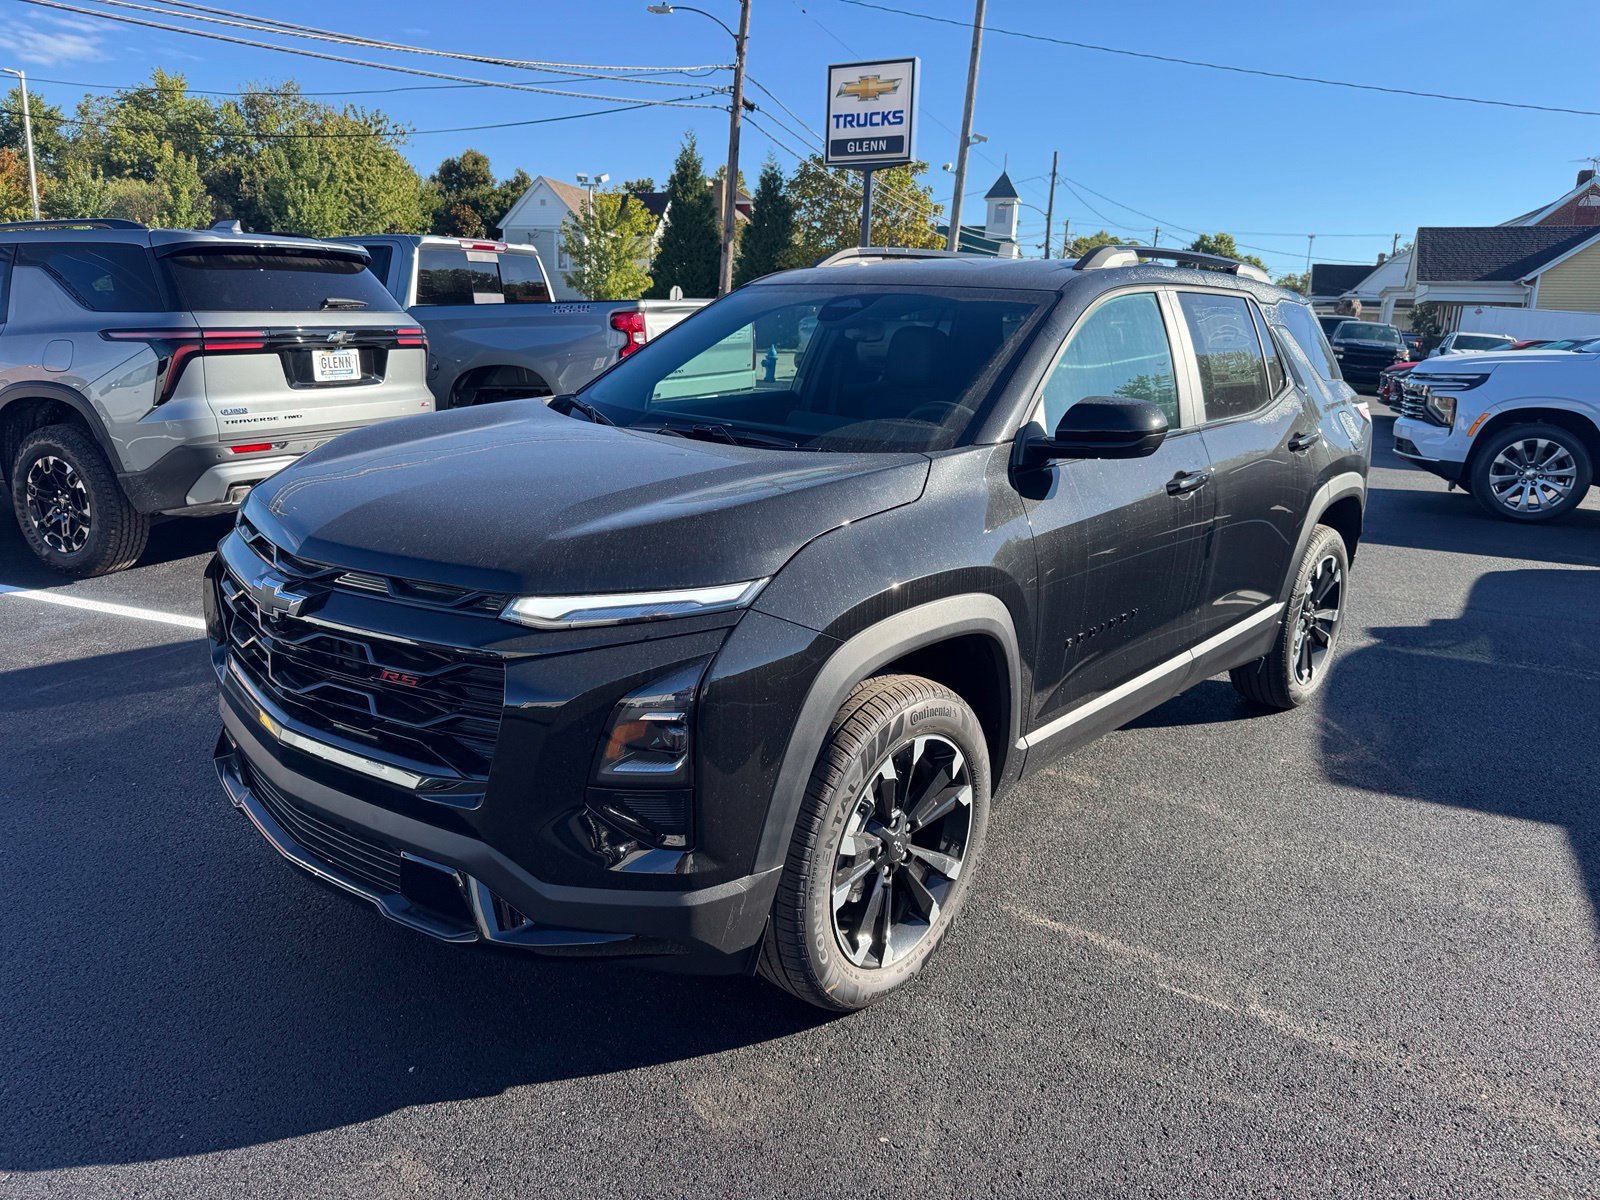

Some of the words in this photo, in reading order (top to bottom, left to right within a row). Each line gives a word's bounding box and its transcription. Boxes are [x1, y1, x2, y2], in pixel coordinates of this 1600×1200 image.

[833, 110, 904, 129] TRUCKS
[847, 140, 887, 153] GLENN
[321, 356, 352, 369] GLENN
[224, 416, 279, 425] TRAVERSE
[382, 671, 418, 687] RS
[910, 706, 952, 725] Continental
[814, 780, 861, 966] CONTINENTAL
